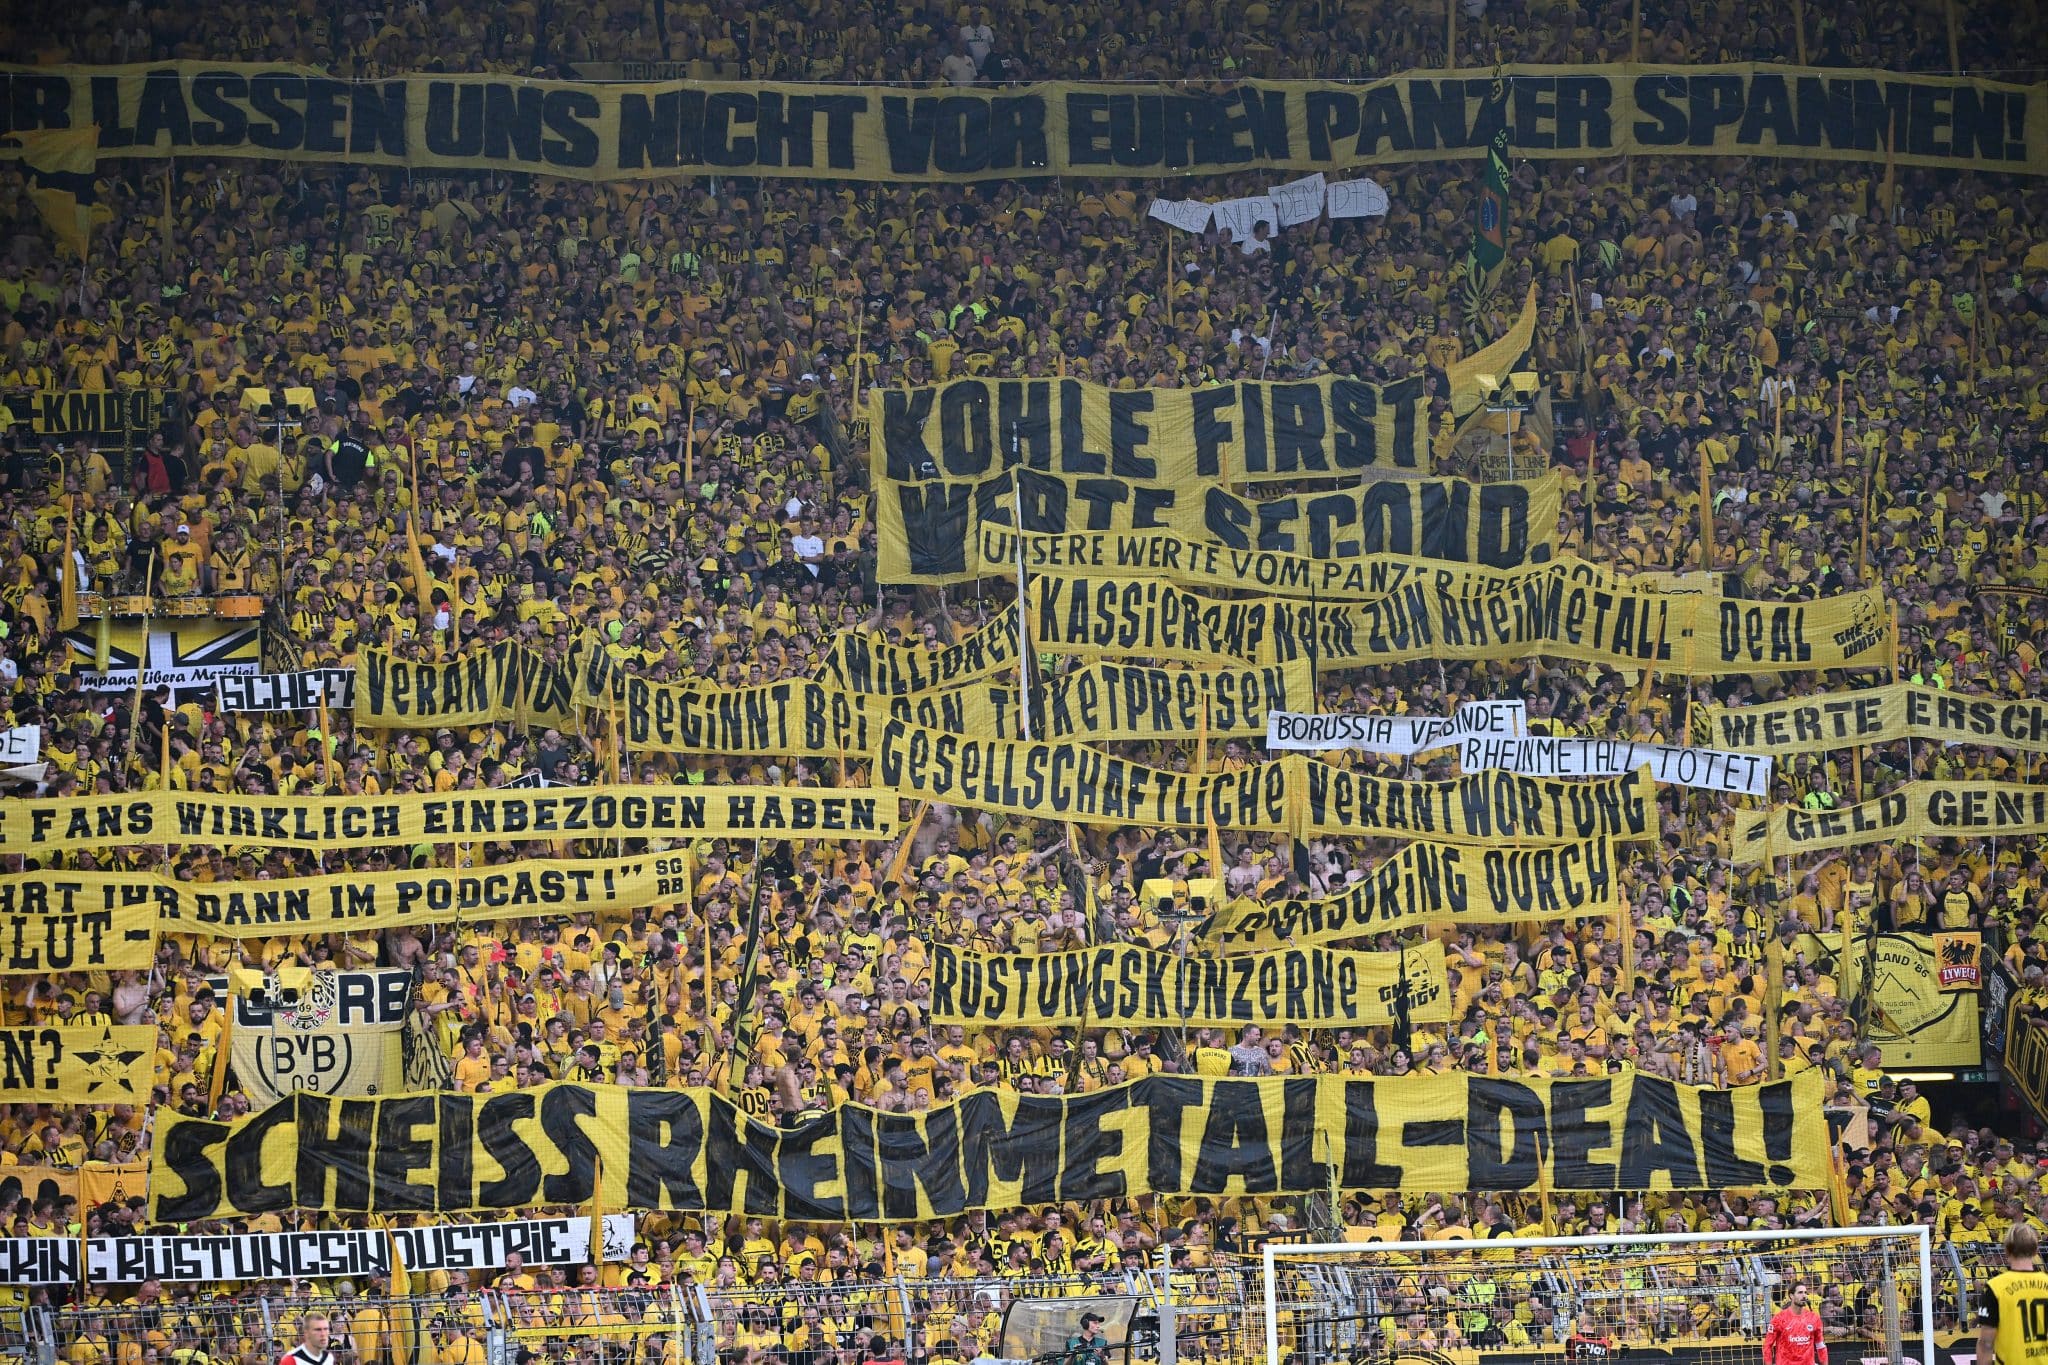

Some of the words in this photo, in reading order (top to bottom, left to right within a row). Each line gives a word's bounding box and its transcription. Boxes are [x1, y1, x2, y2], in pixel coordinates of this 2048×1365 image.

[90, 69, 407, 157] LASSEN
[425, 81, 600, 168] UNS
[618, 89, 867, 170] NICHT
[882, 95, 1046, 174] VOR
[1068, 87, 1289, 168] EUREN
[1306, 75, 1612, 162] PANZER
[1633, 73, 2028, 162] SPANNEN!
[1280, 181, 1321, 220] DEM
[883, 379, 1157, 481] KOHLE
[1190, 375, 1425, 477] FIRST
[898, 468, 1176, 574] WERTE
[1205, 480, 1551, 570] SECOND.
[984, 531, 1105, 567] UNSERE
[1117, 536, 1218, 574] WERTE
[1231, 550, 1311, 588] VOM
[1277, 714, 1393, 745] BORUSSIA
[1720, 697, 1883, 749] WERTE
[1465, 737, 1635, 774] RHEINMETALL
[1656, 746, 1761, 791] TÖTET
[32, 802, 154, 843] FANS
[176, 804, 400, 841] WIRKLICH
[423, 796, 706, 834] EINBEZOGEN
[727, 797, 890, 834] HABEN,
[1786, 793, 1908, 842] GELD
[656, 858, 682, 876] SG
[657, 879, 684, 896] RB
[103, 884, 181, 919] IHR
[196, 887, 310, 925] DANN
[330, 883, 376, 918] IM
[0, 910, 112, 970] LUT
[271, 1034, 336, 1074] BVB
[292, 1074, 319, 1092] 09
[156, 1084, 598, 1223] SCHEISS
[628, 1073, 1797, 1222] RHEINMETALL-DEAL!
